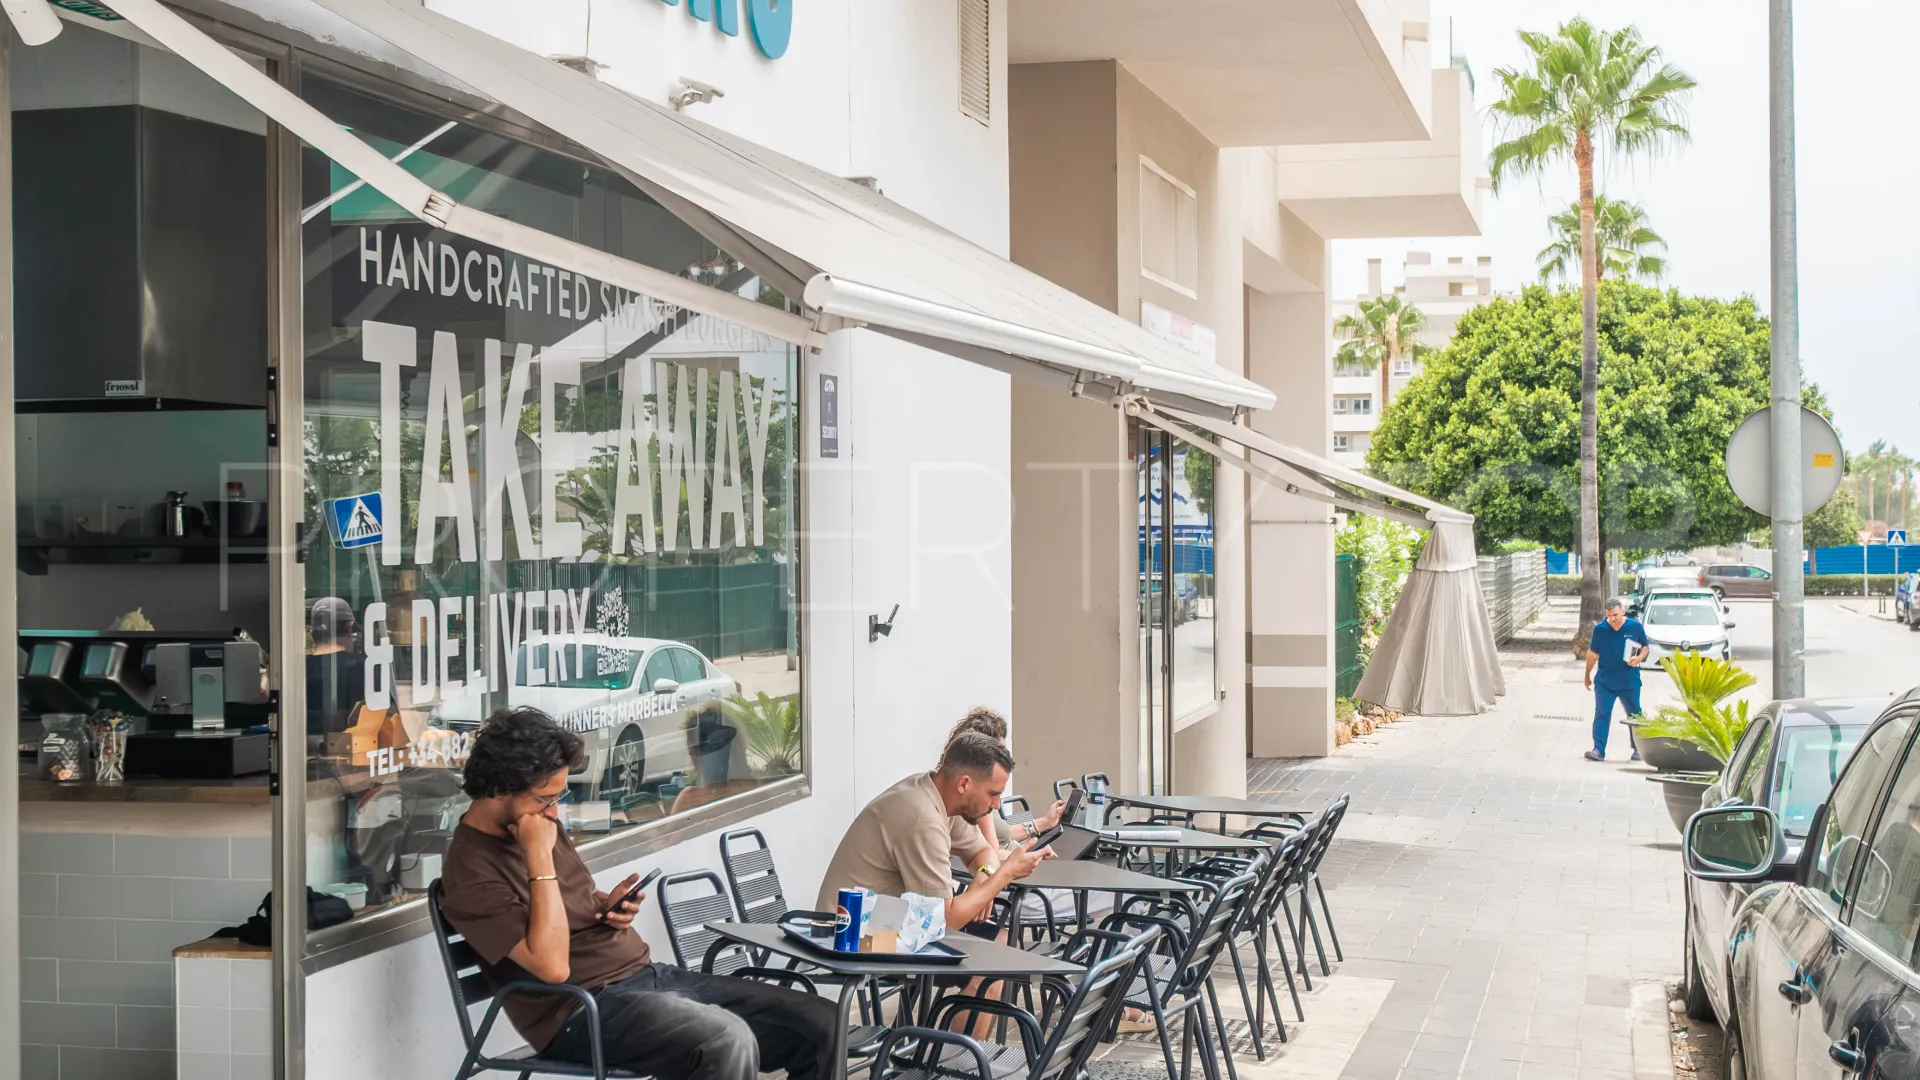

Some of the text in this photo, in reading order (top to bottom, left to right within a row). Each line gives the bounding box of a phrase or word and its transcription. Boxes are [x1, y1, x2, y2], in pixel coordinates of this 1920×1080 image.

[360, 227, 591, 321] HANDCRAFTED
[362, 319, 773, 567] TAKE AWAY
[364, 587, 590, 711] & DELIVERY
[366, 746, 404, 778] TEL:
[617, 692, 679, 723] MARBELLA
